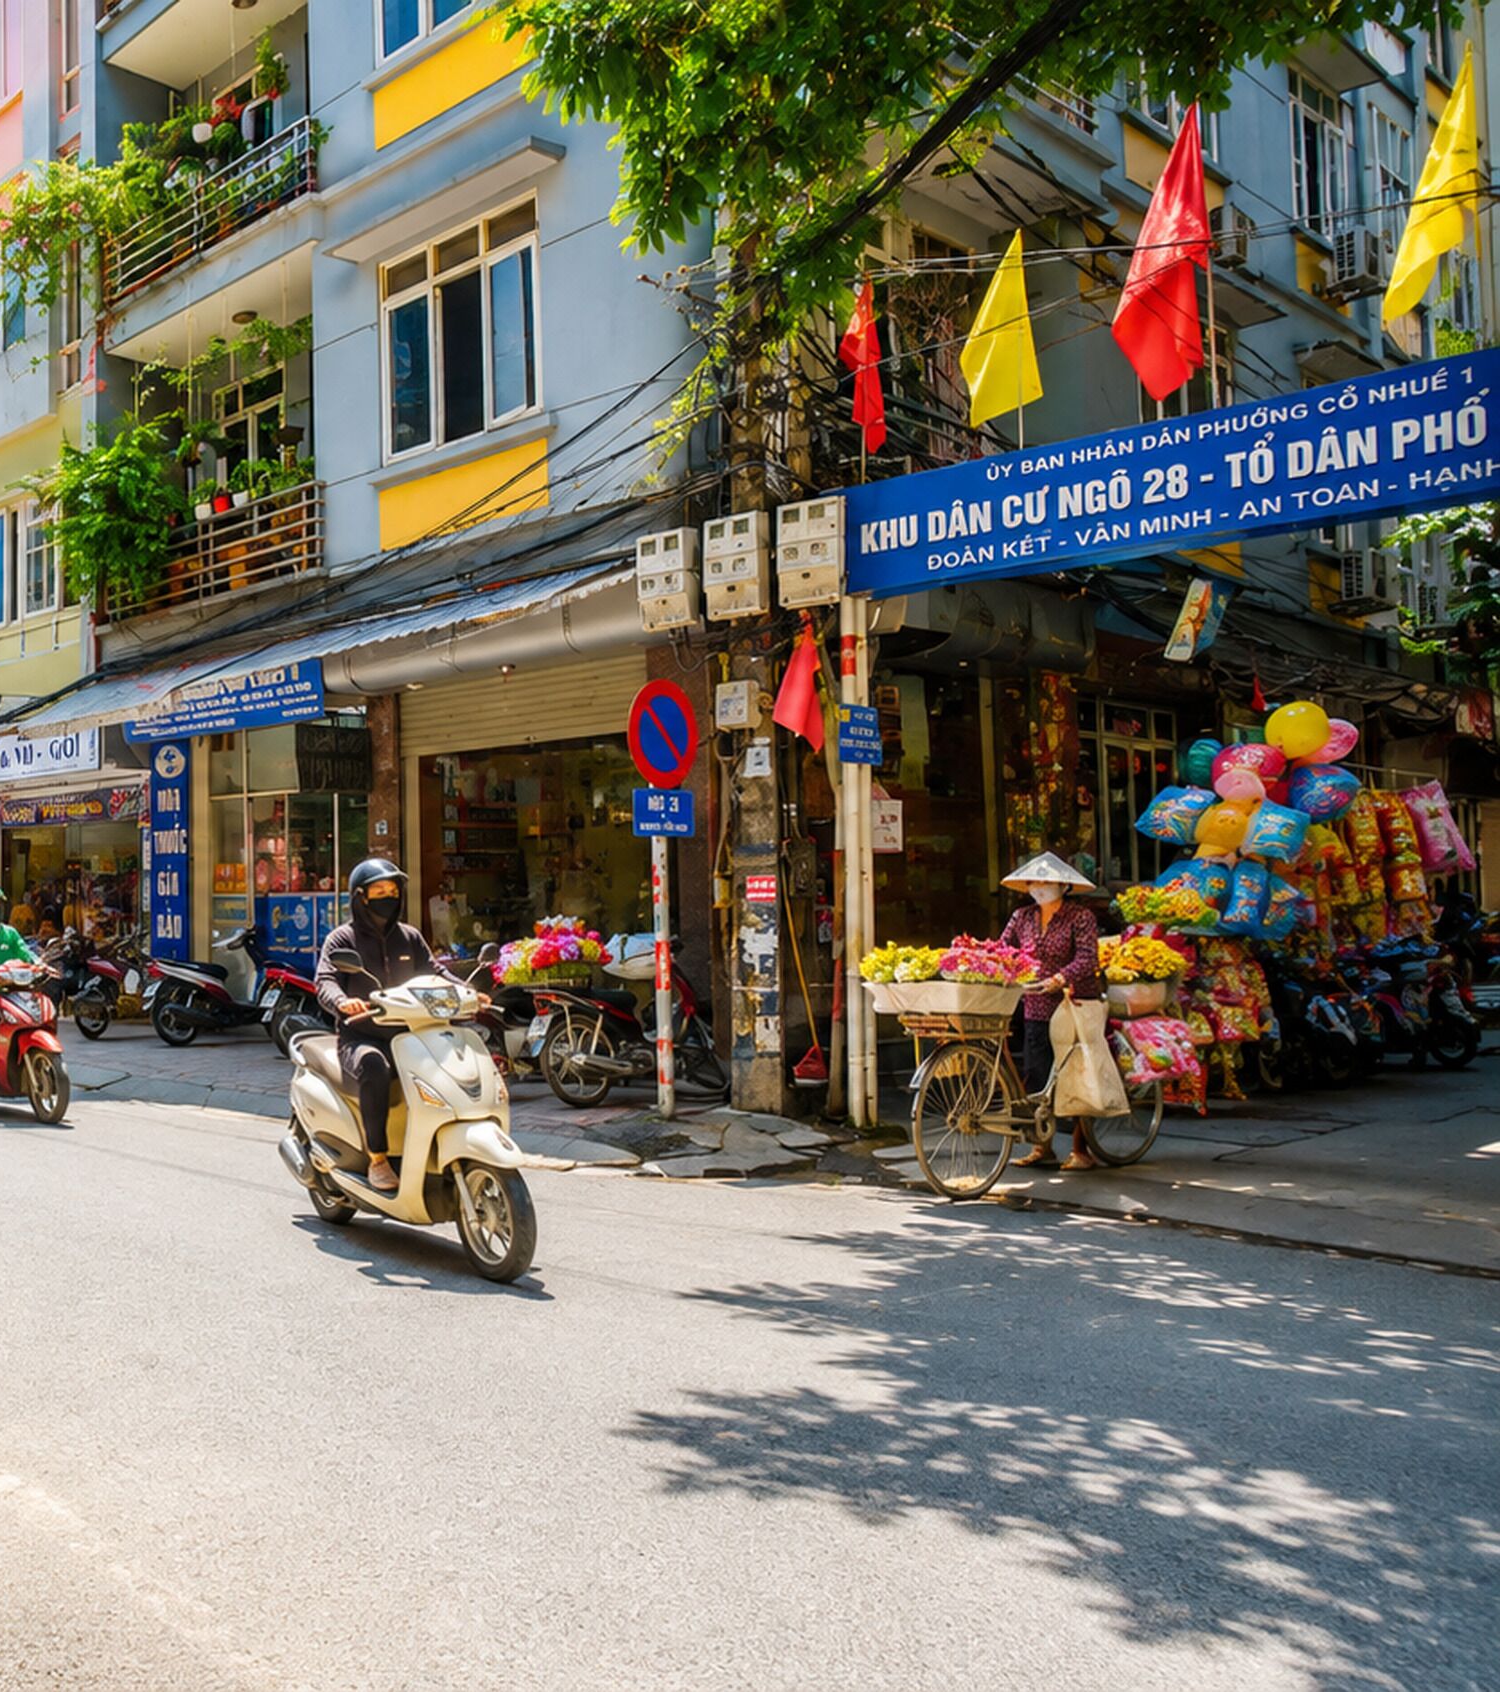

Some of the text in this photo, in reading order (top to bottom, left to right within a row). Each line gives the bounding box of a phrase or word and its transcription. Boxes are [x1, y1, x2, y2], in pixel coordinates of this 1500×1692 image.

[860, 514, 919, 555] KHU
[927, 500, 993, 542] DÂN
[1002, 484, 1050, 529] CƯ
[1143, 464, 1189, 505] 28
[1225, 431, 1276, 489] TỔ
[1287, 426, 1378, 479] DÂN
[1392, 386, 1491, 460] PHỐ
[1020, 453, 1065, 475] BAN
[1140, 508, 1212, 536] MINH
[1238, 495, 1281, 520] AN
[1291, 478, 1380, 510] TOAN
